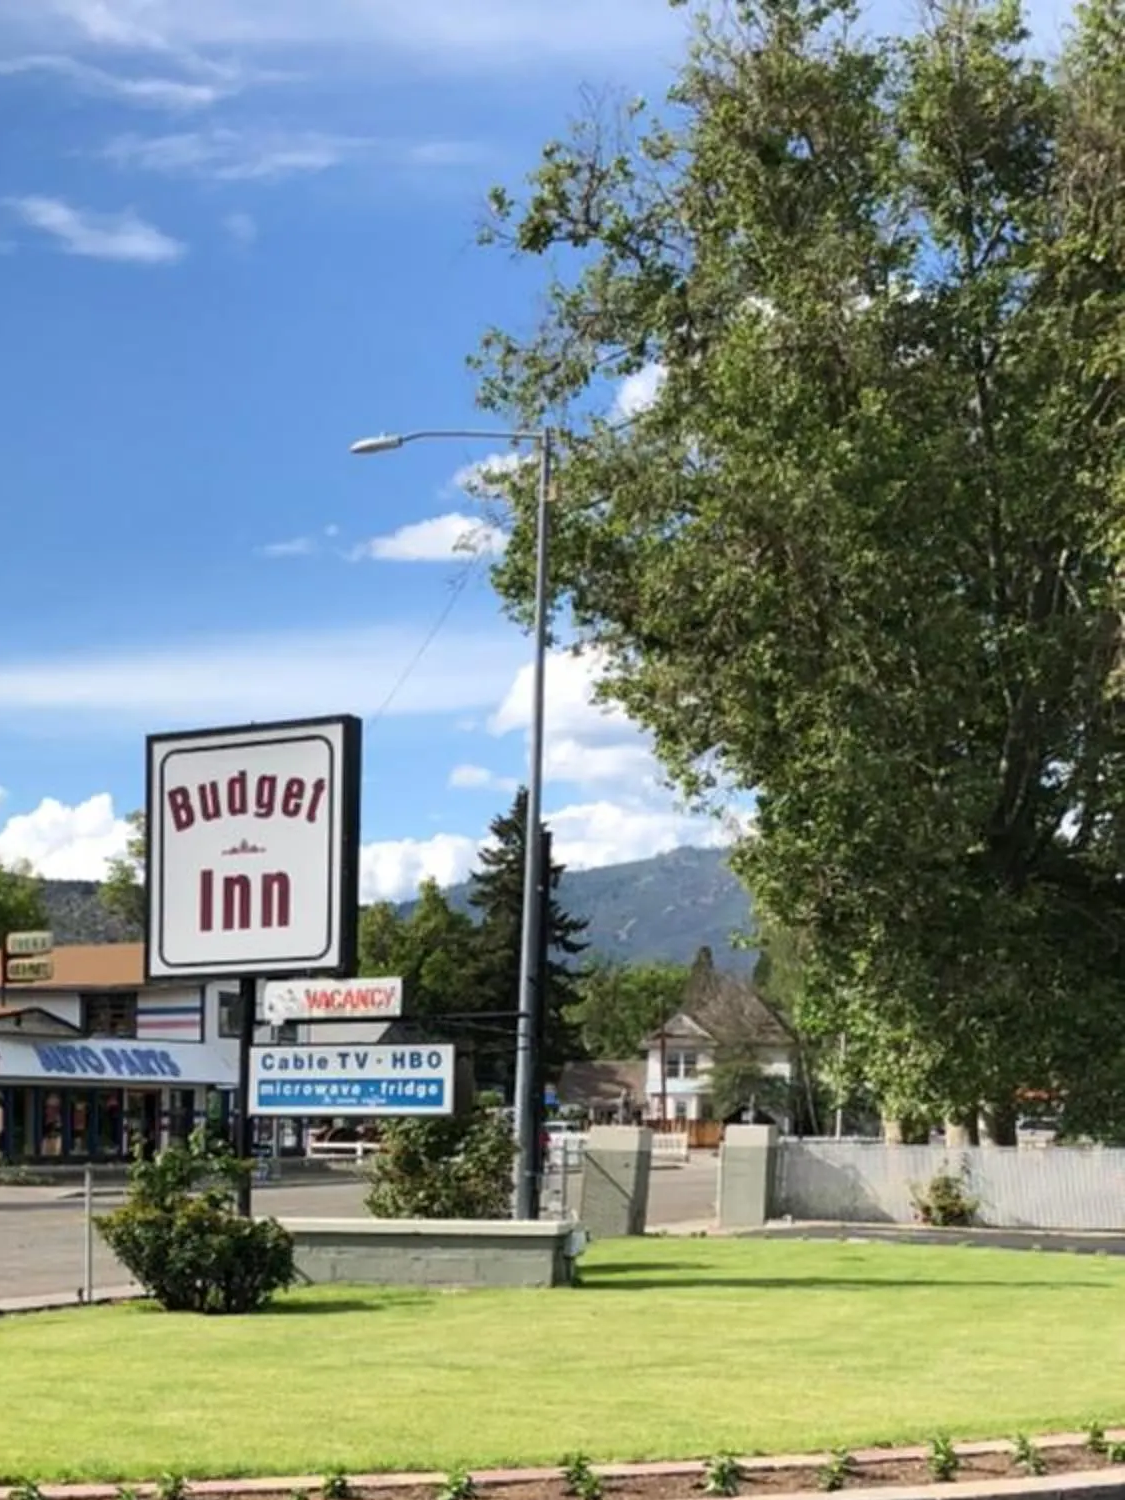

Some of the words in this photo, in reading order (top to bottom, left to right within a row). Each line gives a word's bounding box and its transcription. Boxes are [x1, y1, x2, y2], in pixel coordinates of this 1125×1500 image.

[167, 771, 326, 832] Budget
[199, 869, 290, 932] Inn
[304, 986, 396, 1009] VACANCY
[33, 1044, 107, 1075] AUTO
[101, 1046, 181, 1077] PARTS
[260, 1052, 329, 1071] Cable
[336, 1052, 369, 1070] TV
[391, 1051, 442, 1070] HBO
[259, 1081, 361, 1096] microwave
[380, 1080, 439, 1098] fridge
